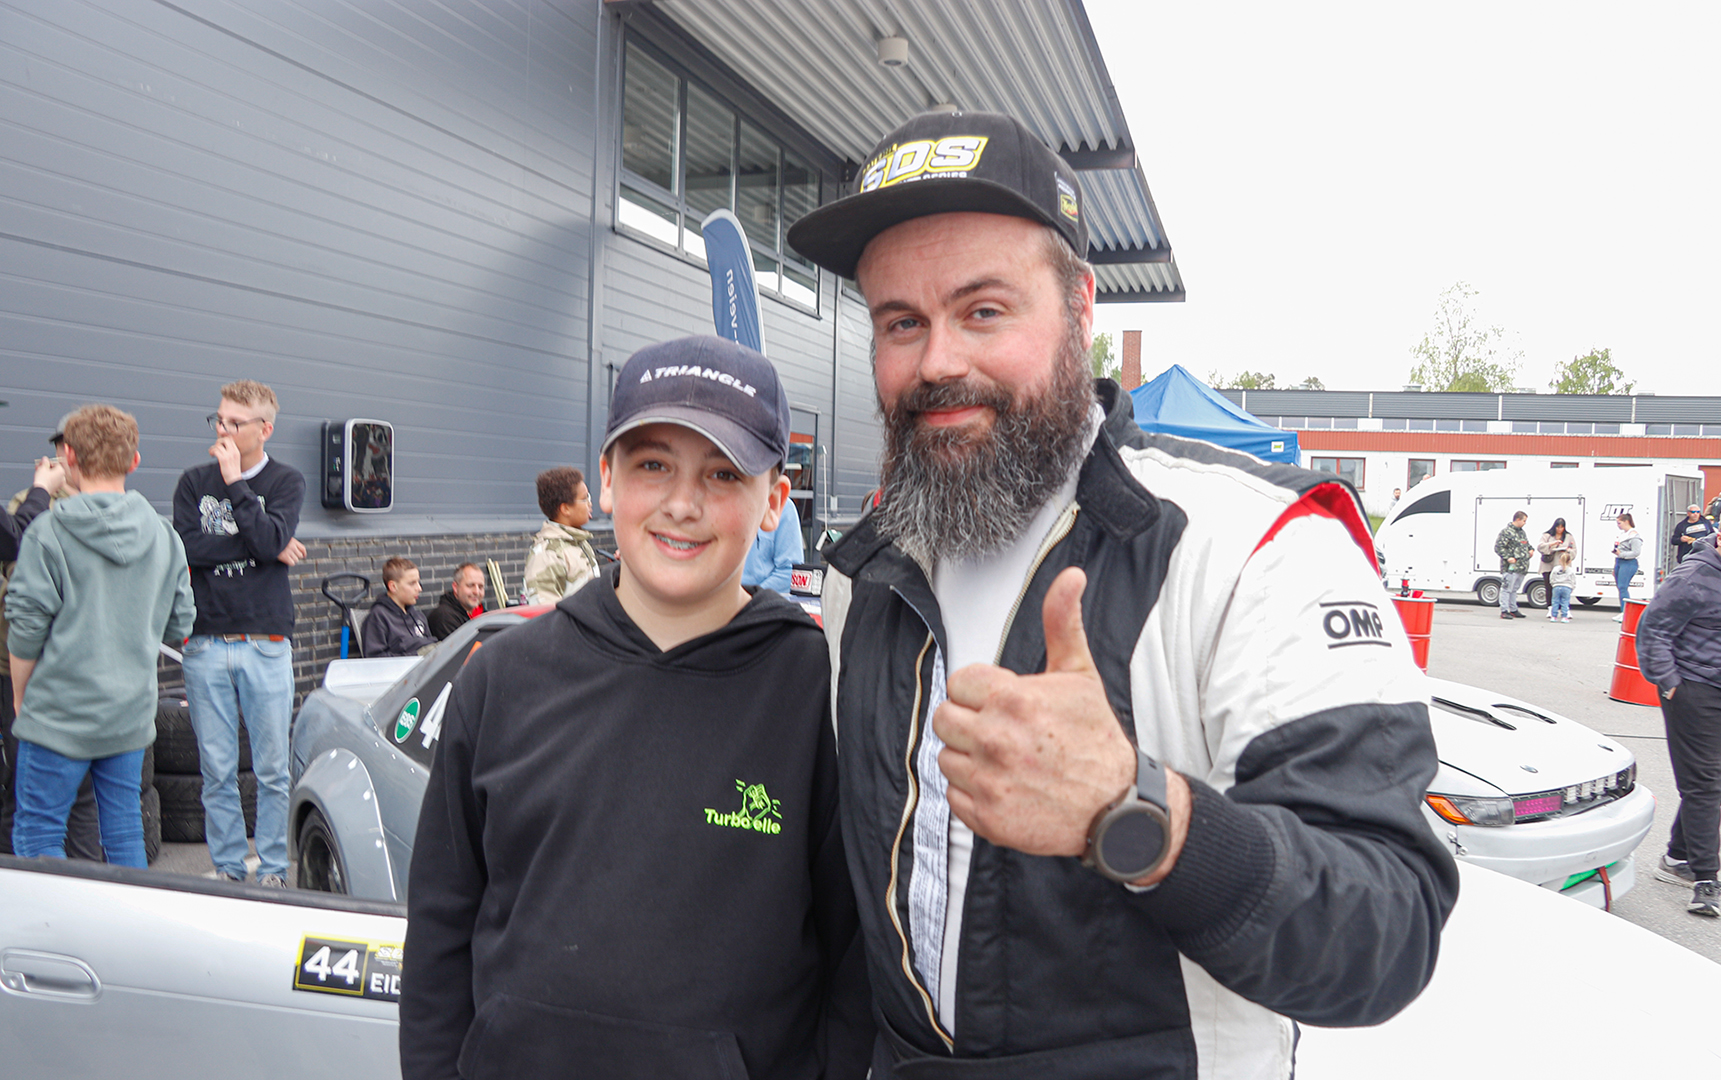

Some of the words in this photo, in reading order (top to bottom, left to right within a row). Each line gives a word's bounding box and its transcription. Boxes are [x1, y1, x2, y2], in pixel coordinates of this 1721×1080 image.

[862, 136, 986, 193] SDS
[654, 365, 757, 398] TRIANGLE
[1323, 608, 1383, 640] OMP
[304, 945, 360, 986] 44
